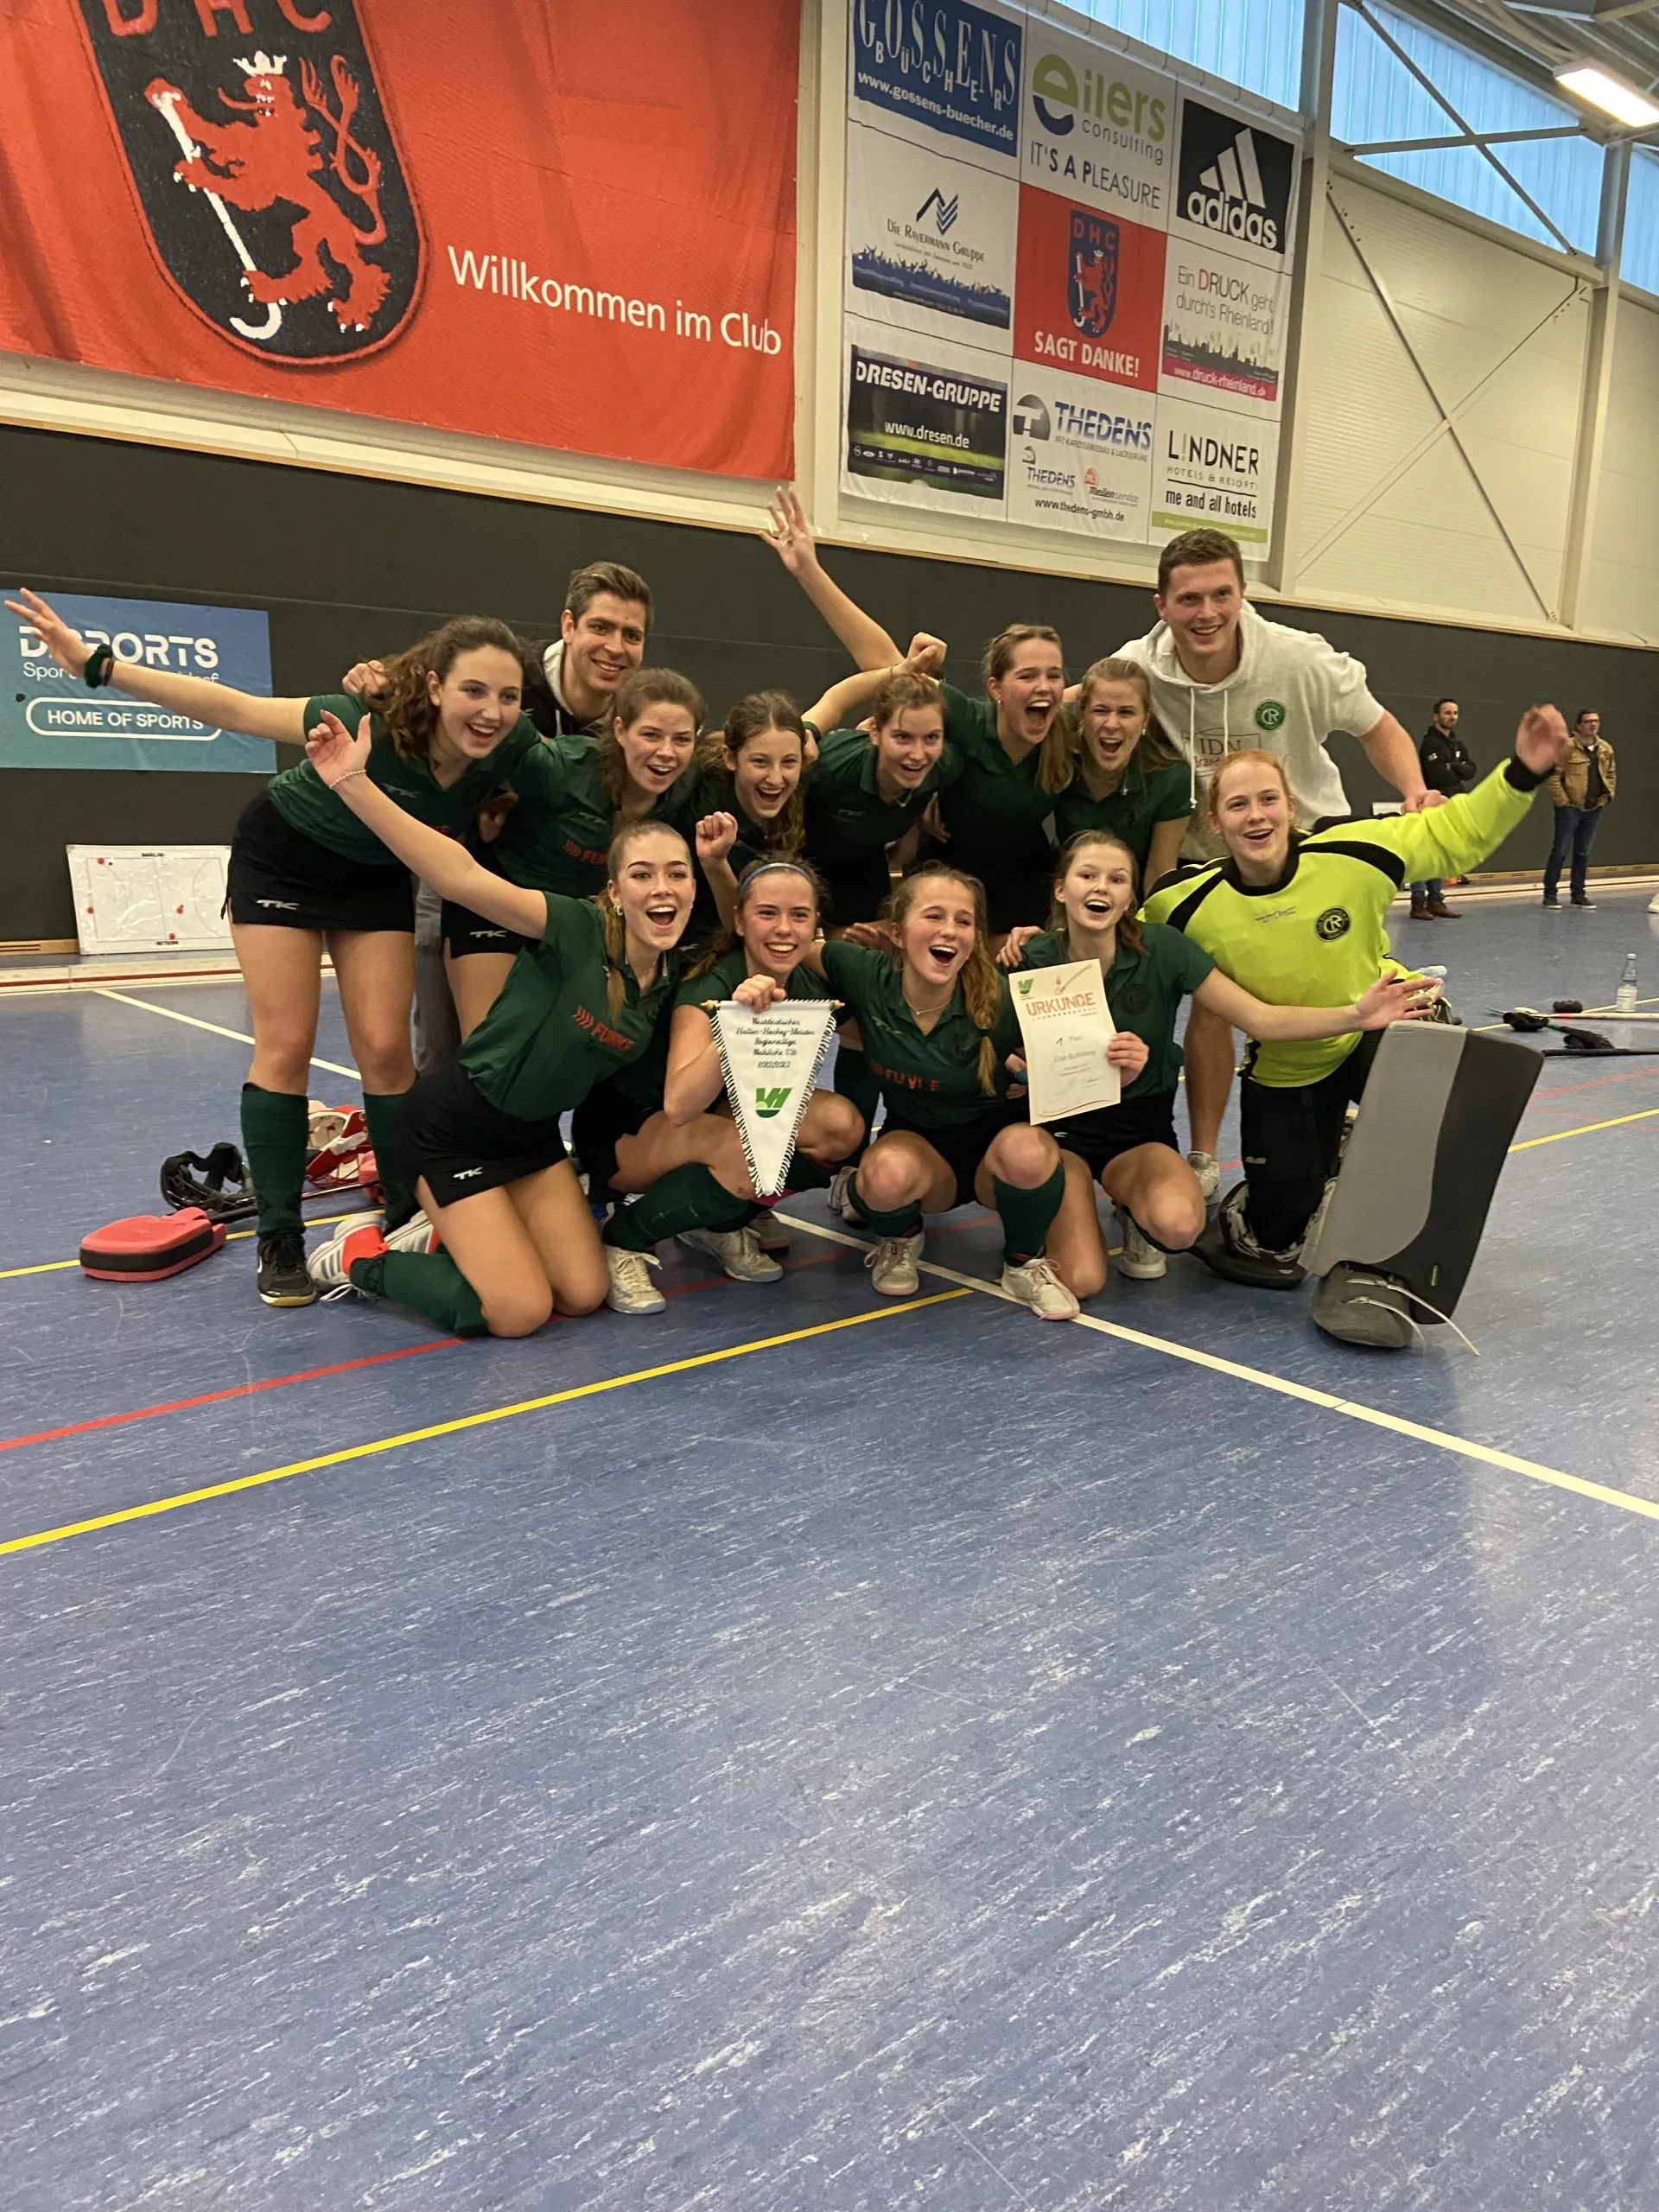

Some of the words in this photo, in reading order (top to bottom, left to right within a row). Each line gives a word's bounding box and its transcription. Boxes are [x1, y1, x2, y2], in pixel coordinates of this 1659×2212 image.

[857, 72, 1014, 140] www.gossens-buecher.de
[1032, 53, 1165, 143] eilers
[1082, 119, 1164, 166] consulting
[1030, 140, 1058, 172] IT'S
[1064, 154, 1077, 180] A
[1082, 160, 1161, 209] PLEASURE
[1073, 218, 1116, 251] DHC
[1186, 189, 1278, 250] adidas
[447, 245, 666, 332] Willkommen
[675, 299, 711, 342] im
[719, 312, 782, 356] Club
[1176, 293, 1217, 320] durch's
[1177, 265, 1196, 289] Ein
[1198, 268, 1250, 306] DRUCK
[1034, 330, 1078, 361] SAGT
[1081, 342, 1141, 378] DANKE!
[855, 360, 1001, 413] DRESEN-GRUPPE
[884, 421, 970, 448] www.dresen.de
[1054, 401, 1153, 451] THEDENS
[1027, 467, 1076, 489] THEDENS
[1166, 465, 1204, 480] HOTELS
[1166, 490, 1182, 505] me
[1185, 493, 1206, 510] and
[1209, 494, 1223, 513] all
[1224, 496, 1257, 518] hotels
[48, 710, 103, 727] HOME
[107, 712, 132, 729] OF
[136, 714, 205, 731] SPORTS
[1025, 991, 1097, 1017] URKUNDE
